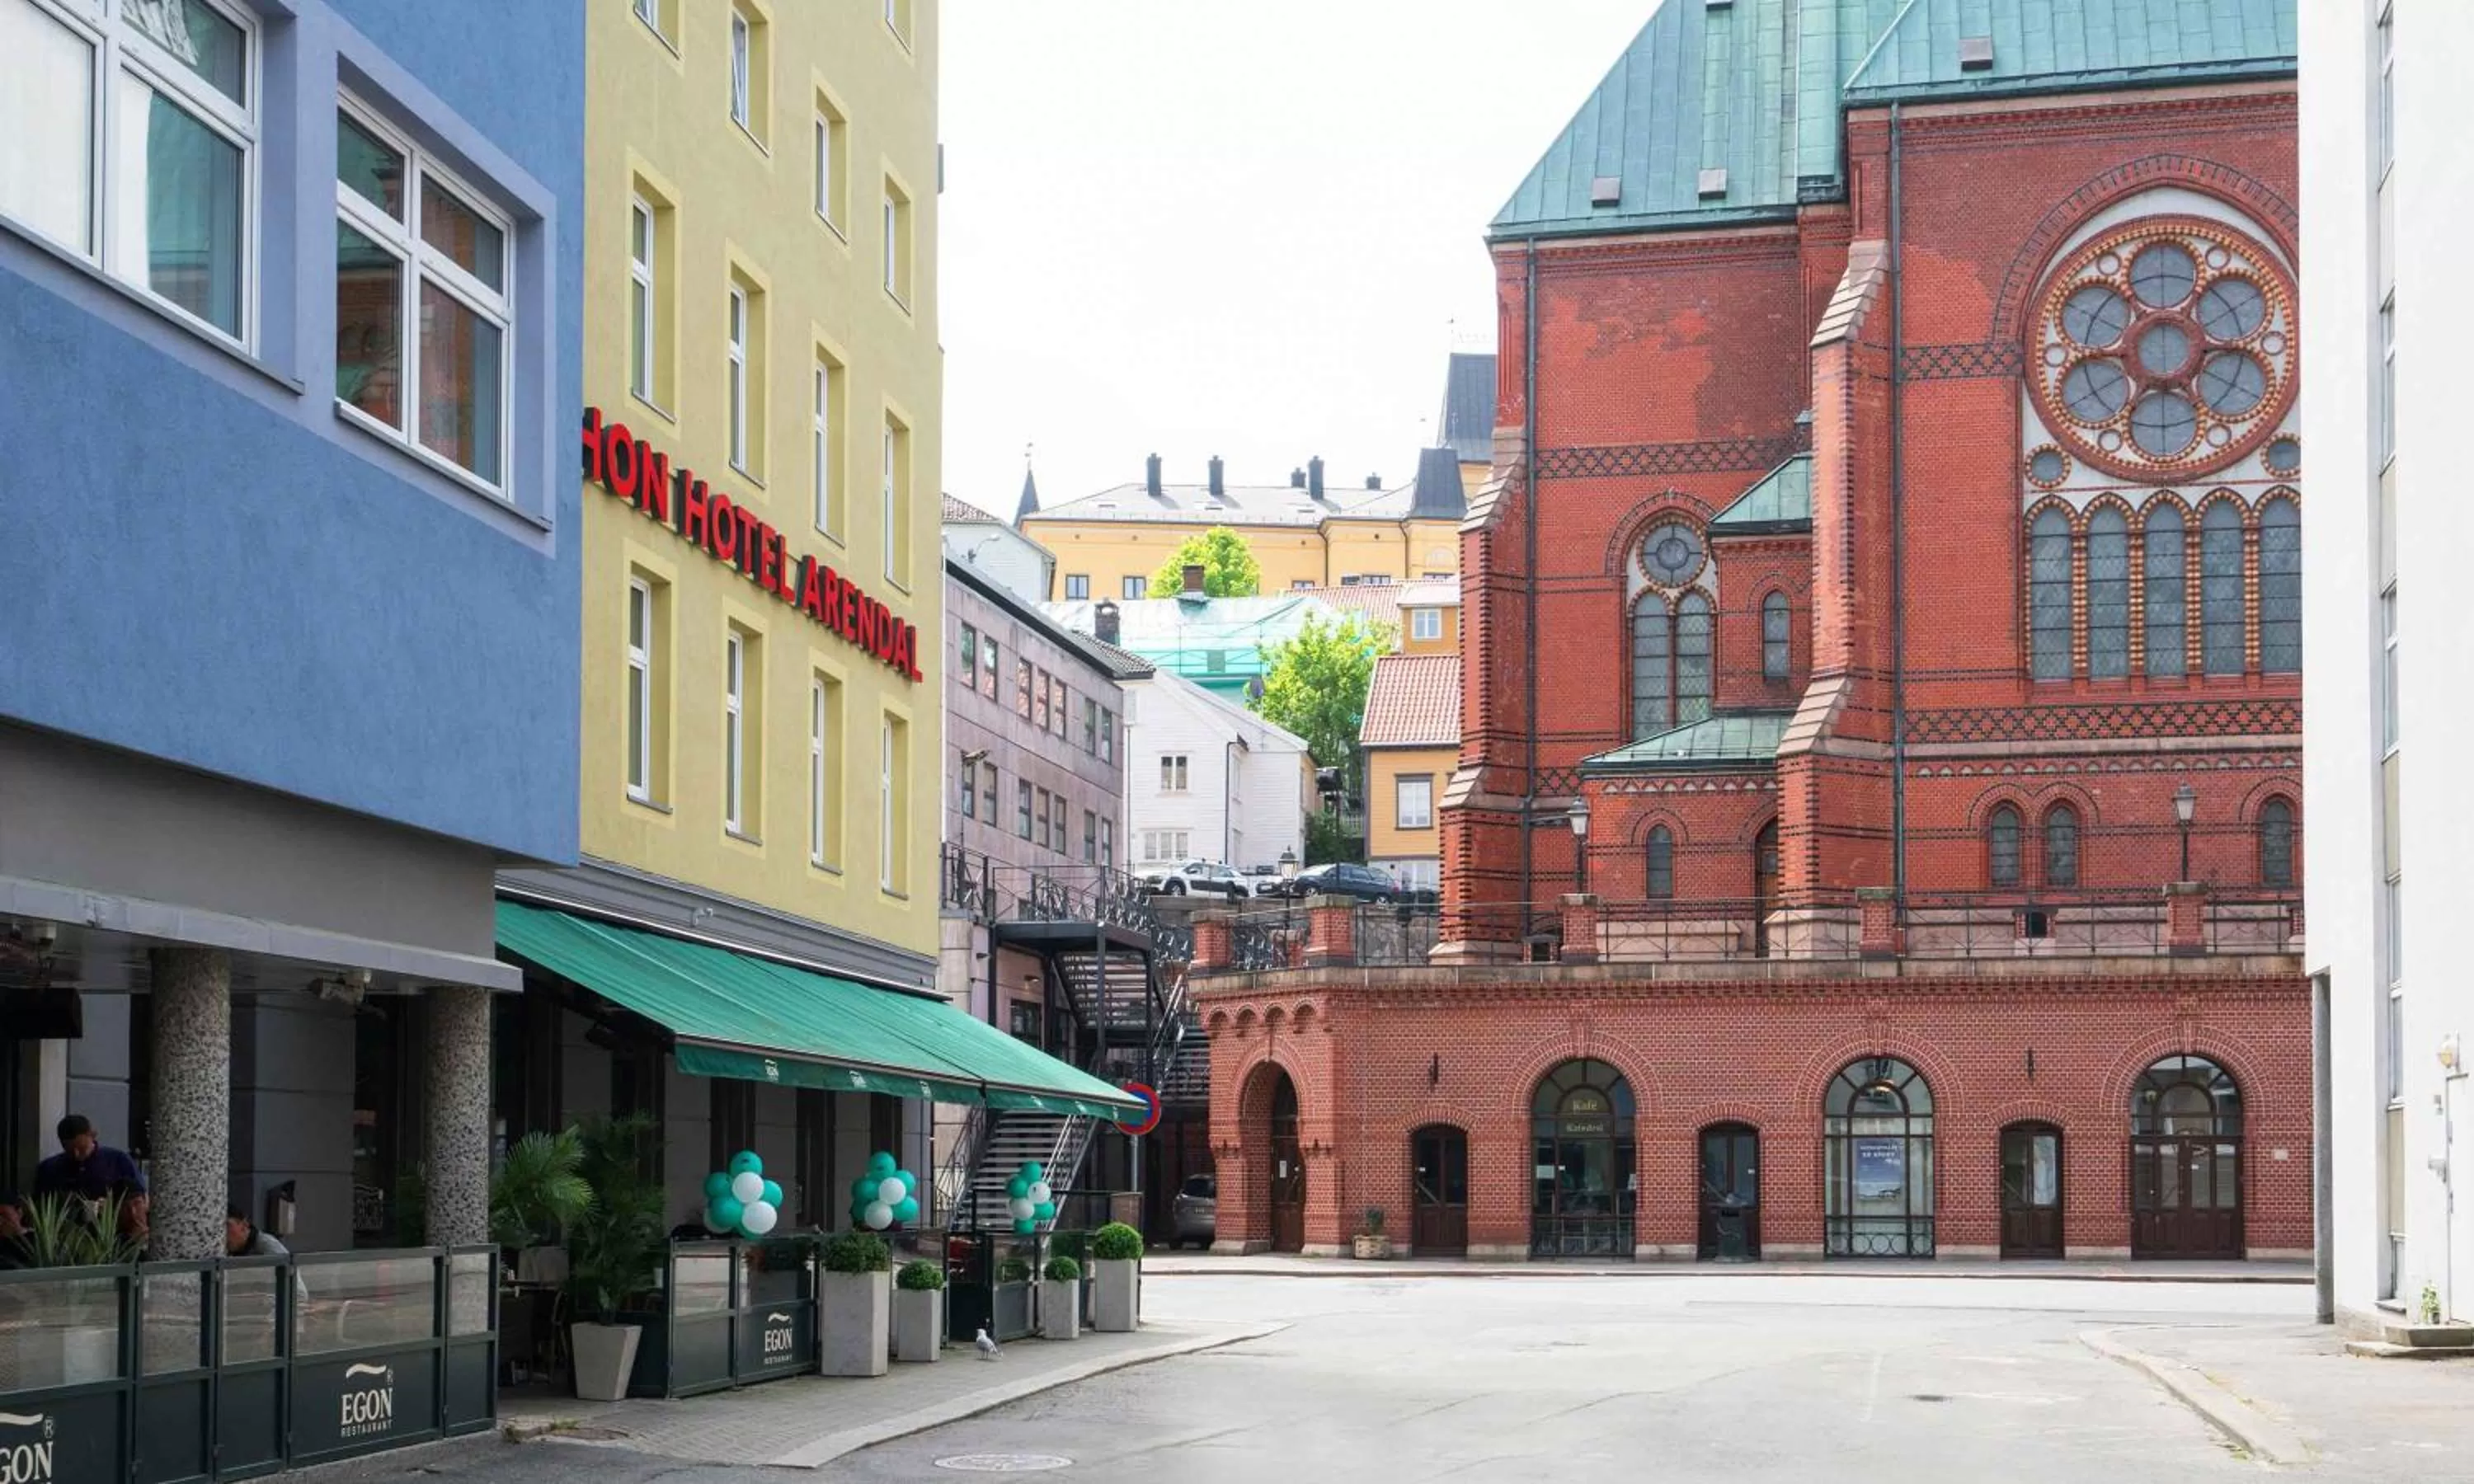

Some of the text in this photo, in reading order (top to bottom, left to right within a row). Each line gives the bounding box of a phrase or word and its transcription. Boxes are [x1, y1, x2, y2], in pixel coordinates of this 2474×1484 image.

[675, 467, 796, 604] HOTEL
[795, 554, 923, 683] ARENDAL
[764, 1328, 793, 1352] EGON
[341, 1387, 393, 1425] EGON
